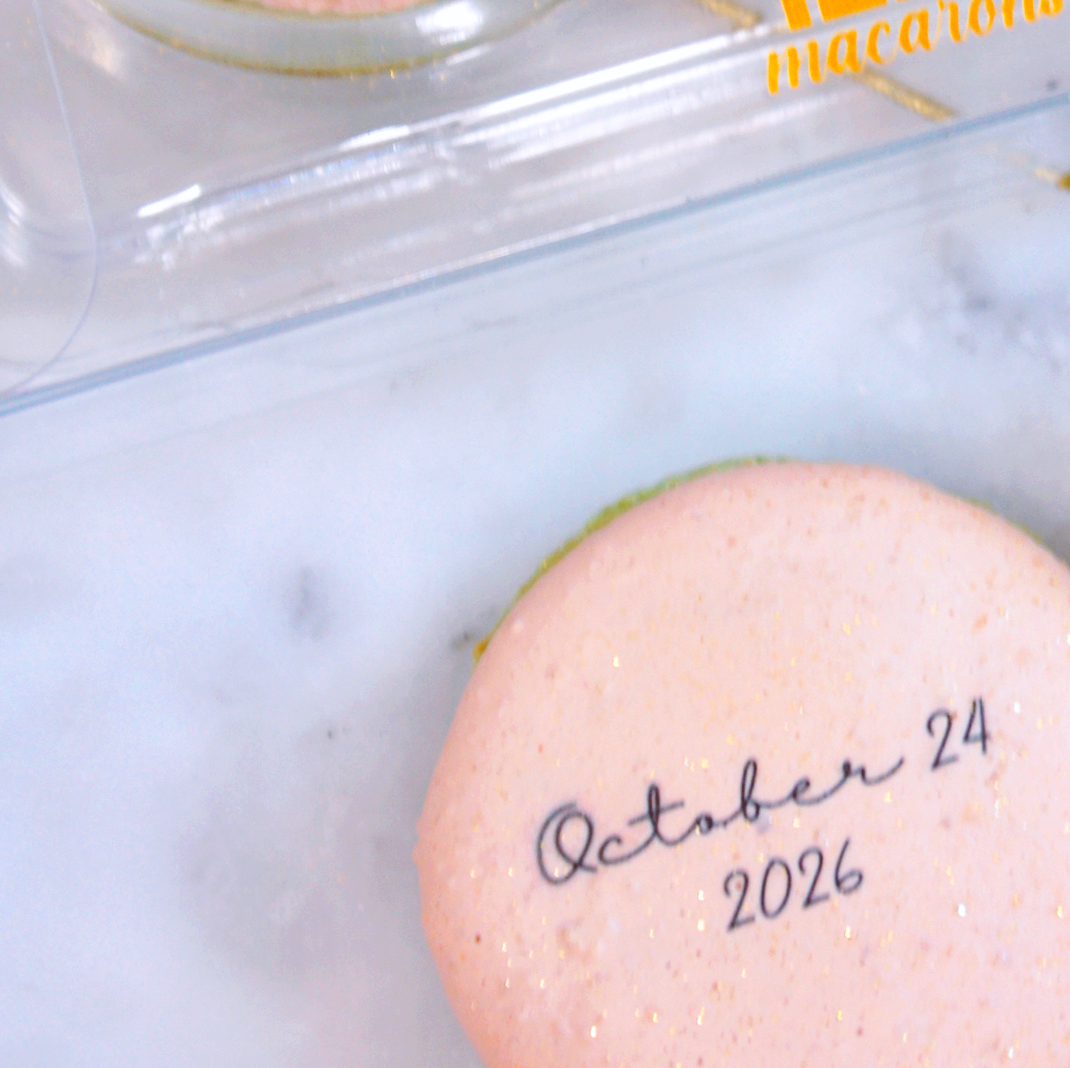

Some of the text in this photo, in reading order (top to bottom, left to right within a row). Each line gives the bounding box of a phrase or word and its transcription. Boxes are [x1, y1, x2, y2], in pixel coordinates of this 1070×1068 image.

[536, 696, 990, 886] October 24
[722, 838, 864, 932] 2026
